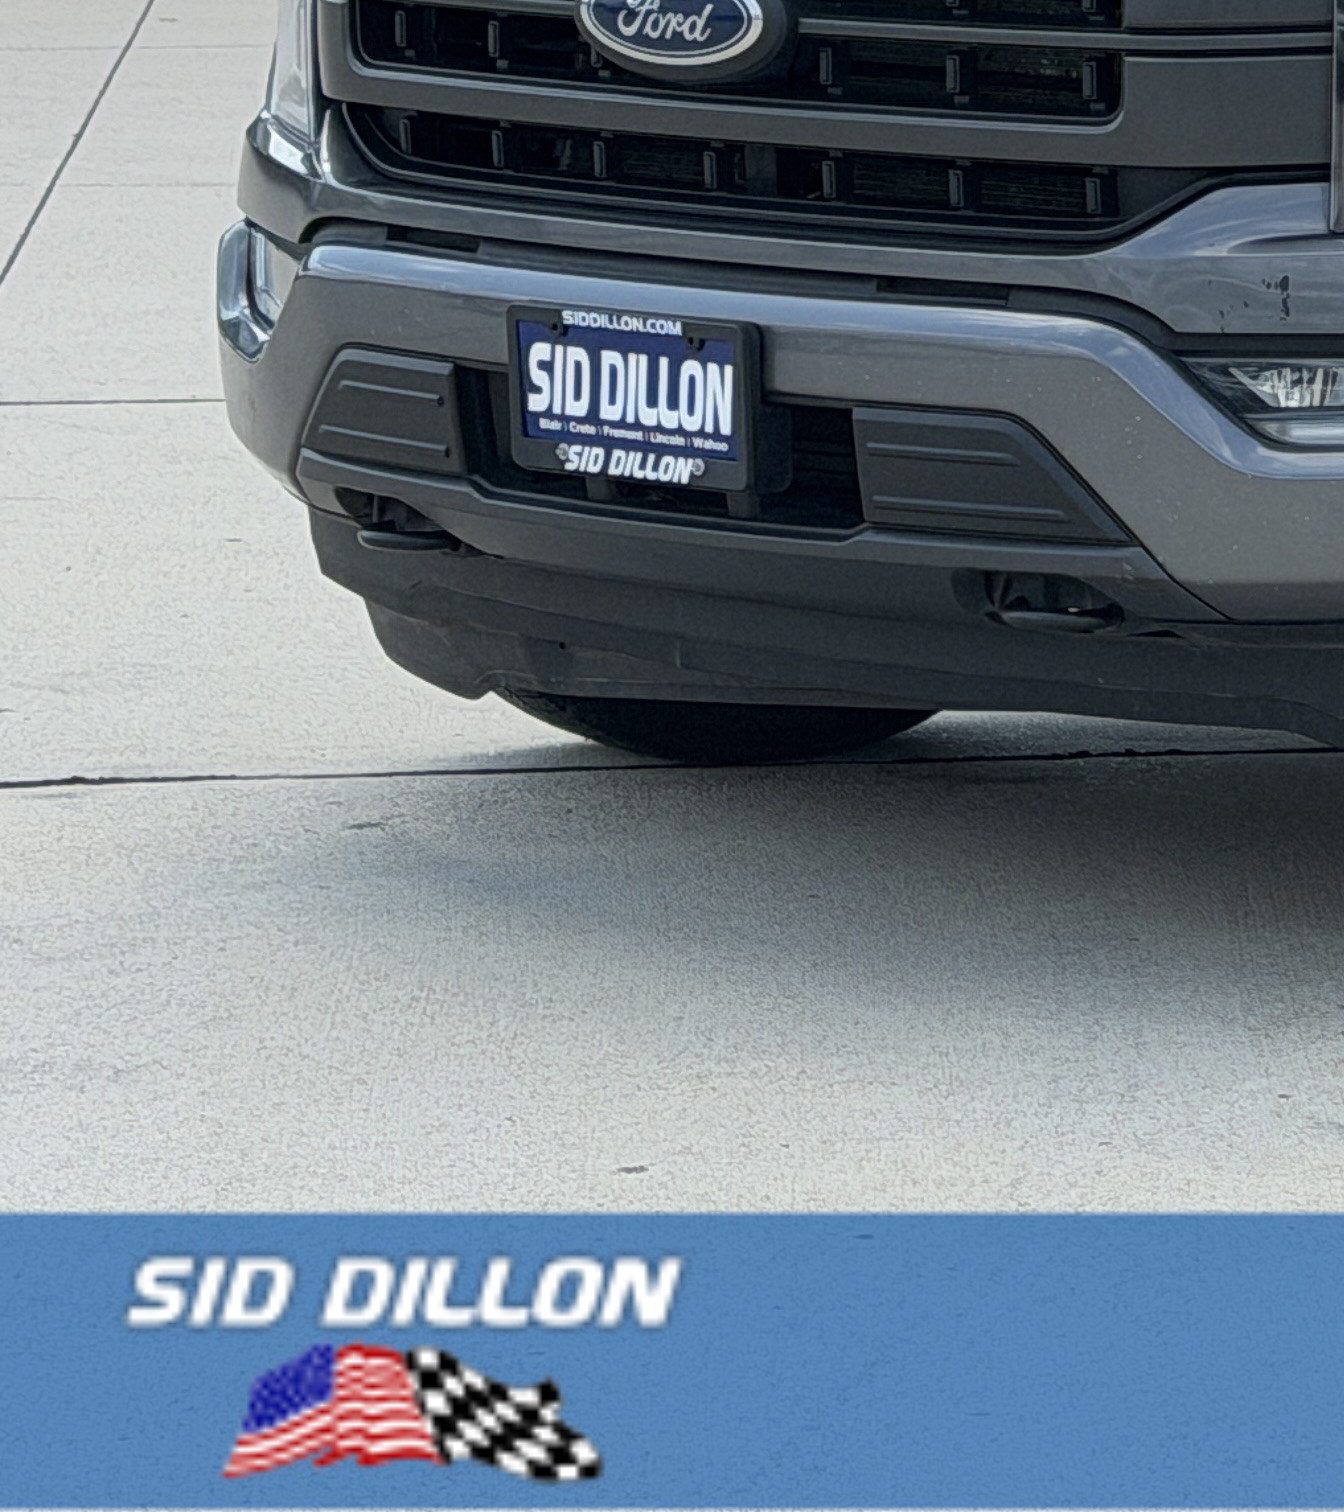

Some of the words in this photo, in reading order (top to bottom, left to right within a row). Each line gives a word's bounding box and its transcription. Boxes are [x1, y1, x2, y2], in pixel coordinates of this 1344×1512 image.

[562, 310, 682, 336] SIDDILLON.COM
[527, 342, 591, 418] SID
[599, 350, 734, 436] DILLON
[604, 426, 643, 441] Fremont
[692, 437, 729, 452] Wahoo
[564, 445, 605, 473] SID
[608, 449, 696, 485] DILLON
